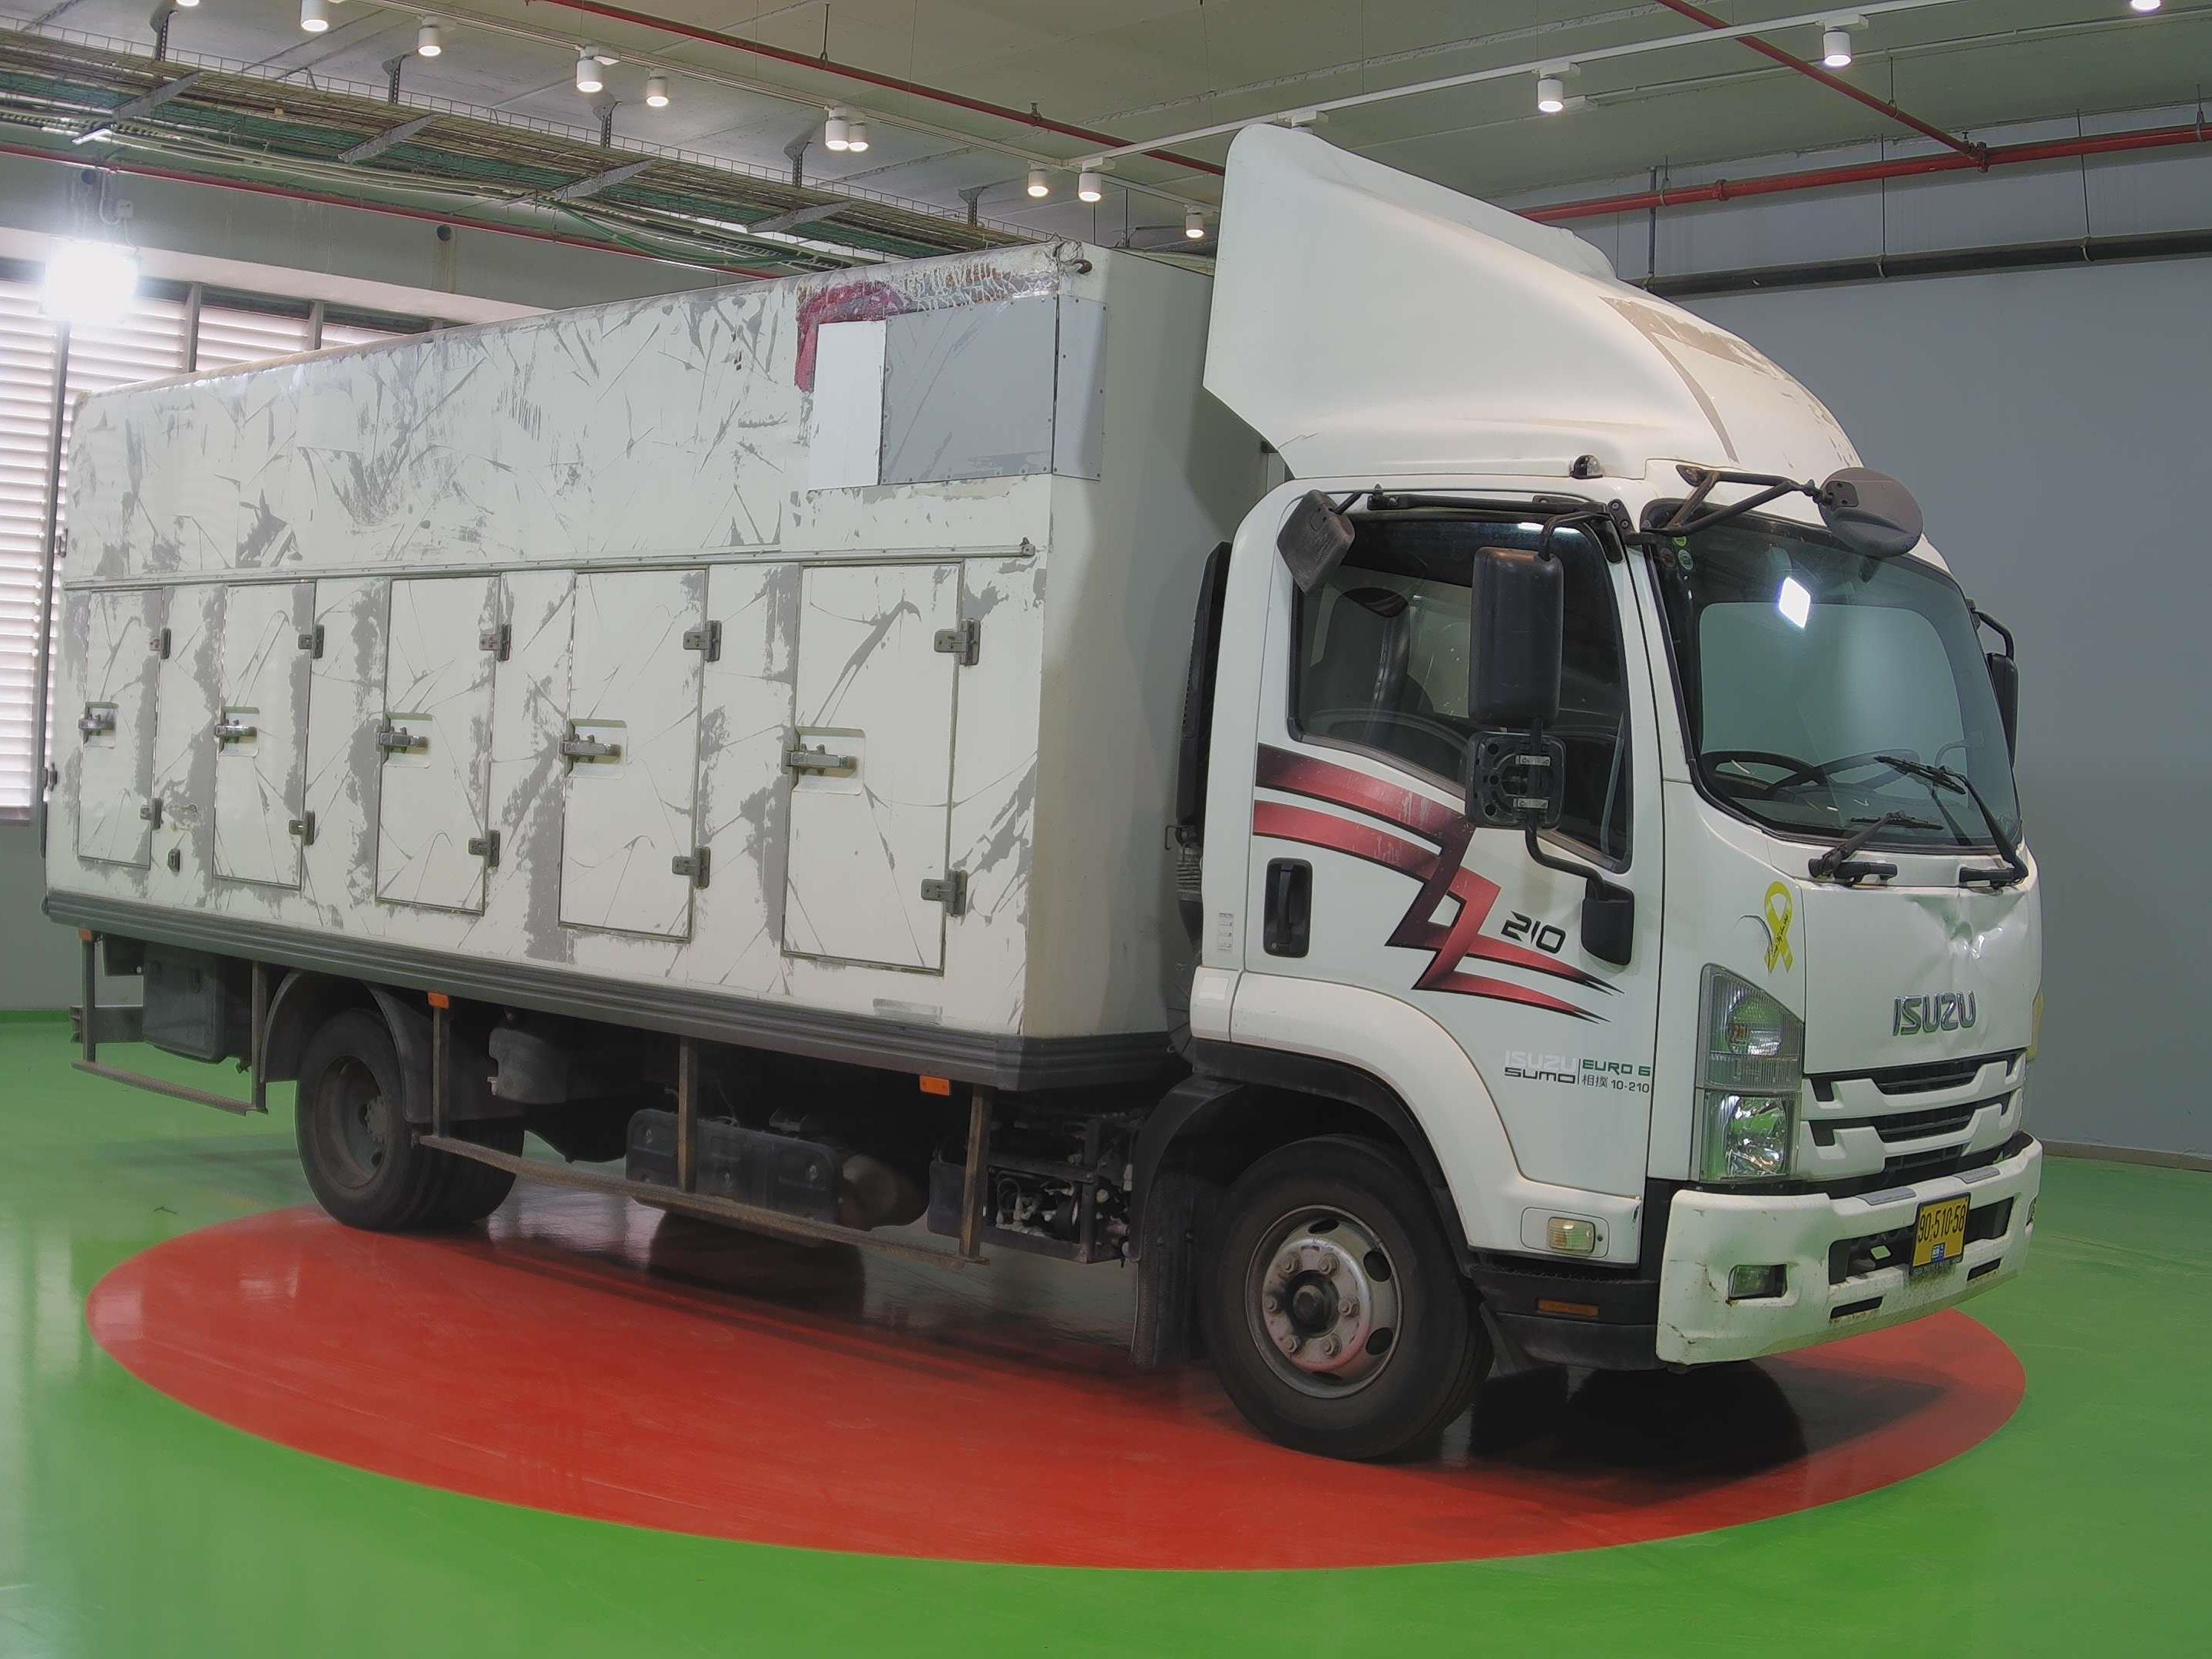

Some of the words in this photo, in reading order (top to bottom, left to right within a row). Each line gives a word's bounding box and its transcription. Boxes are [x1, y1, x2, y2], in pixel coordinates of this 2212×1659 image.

[1501, 910, 1566, 954] 210
[1892, 990, 1976, 1036] ISUZU
[1505, 1050, 1578, 1071] ISUZU
[1582, 1058, 1634, 1075] EURO
[1637, 1065, 1651, 1077] 6
[1504, 1067, 1576, 1084] SUMO
